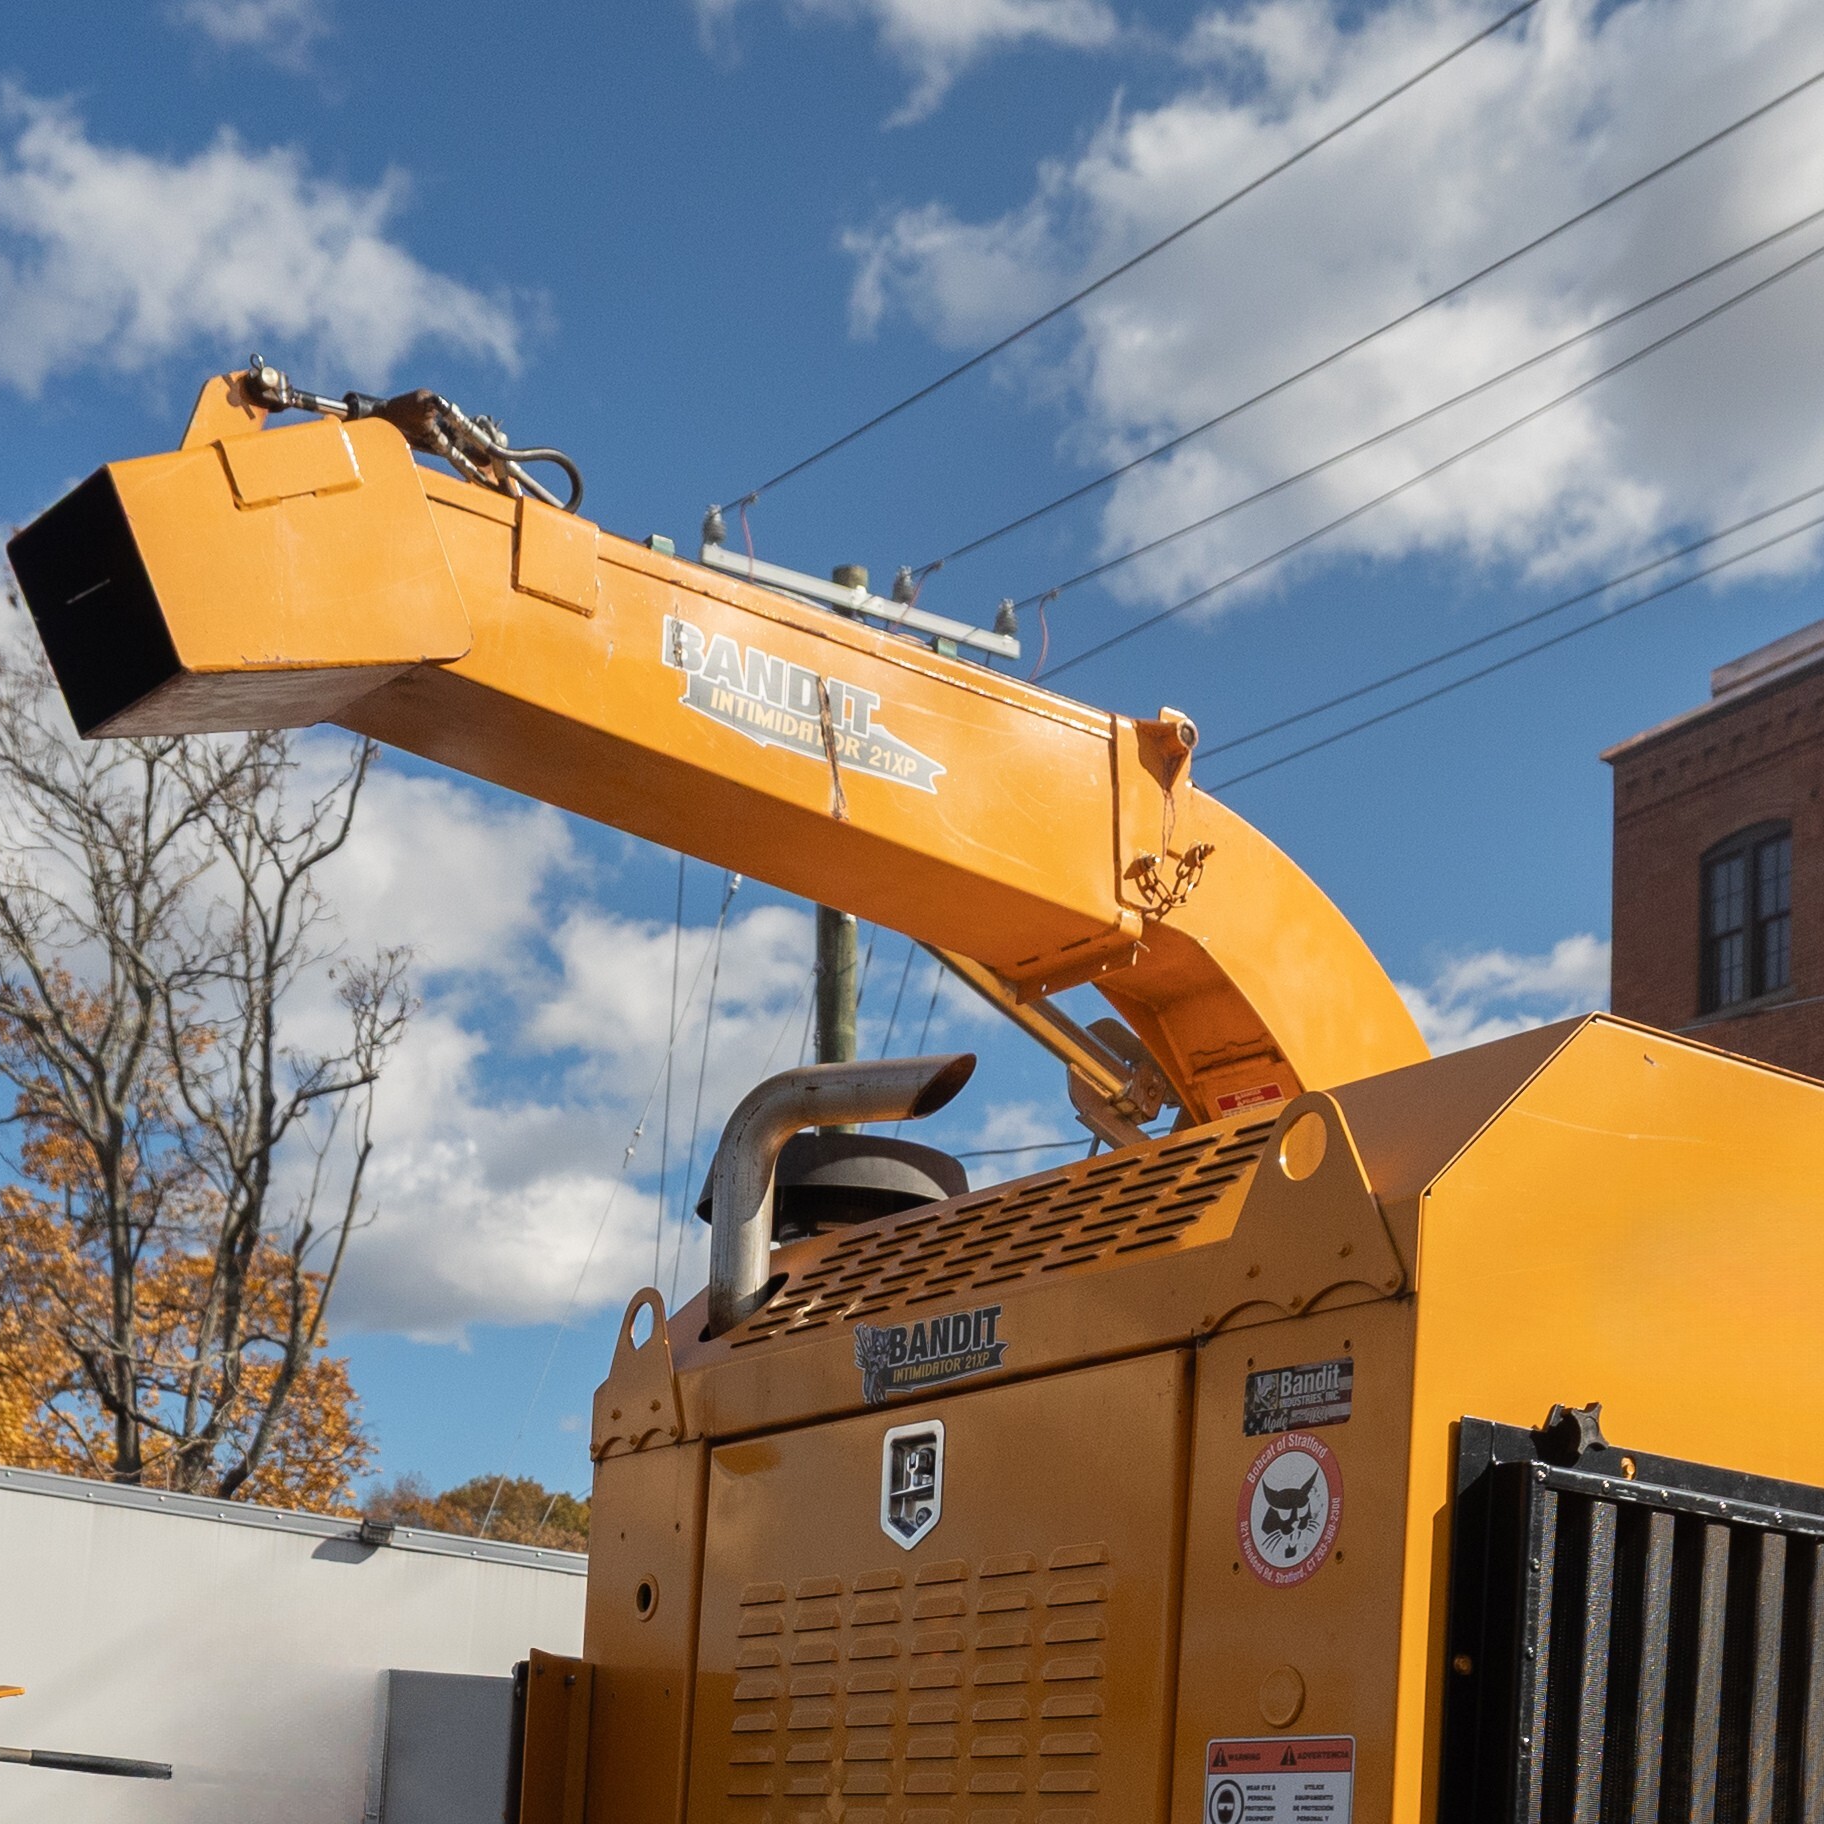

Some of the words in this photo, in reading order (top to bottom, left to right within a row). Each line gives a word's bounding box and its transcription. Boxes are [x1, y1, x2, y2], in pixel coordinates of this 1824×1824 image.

[662, 615, 880, 738] BANDIT
[869, 744, 918, 778] 21XP
[888, 1305, 1002, 1366] BANDIT
[893, 1358, 960, 1383] INTIMIDATOR
[964, 1352, 990, 1370] 21XP
[1280, 1364, 1340, 1397] Bandit
[1262, 1415, 1288, 1431] Made
[1247, 1447, 1276, 1484] Bobcat
[1277, 1436, 1287, 1451] of
[1288, 1433, 1329, 1459] Stratford
